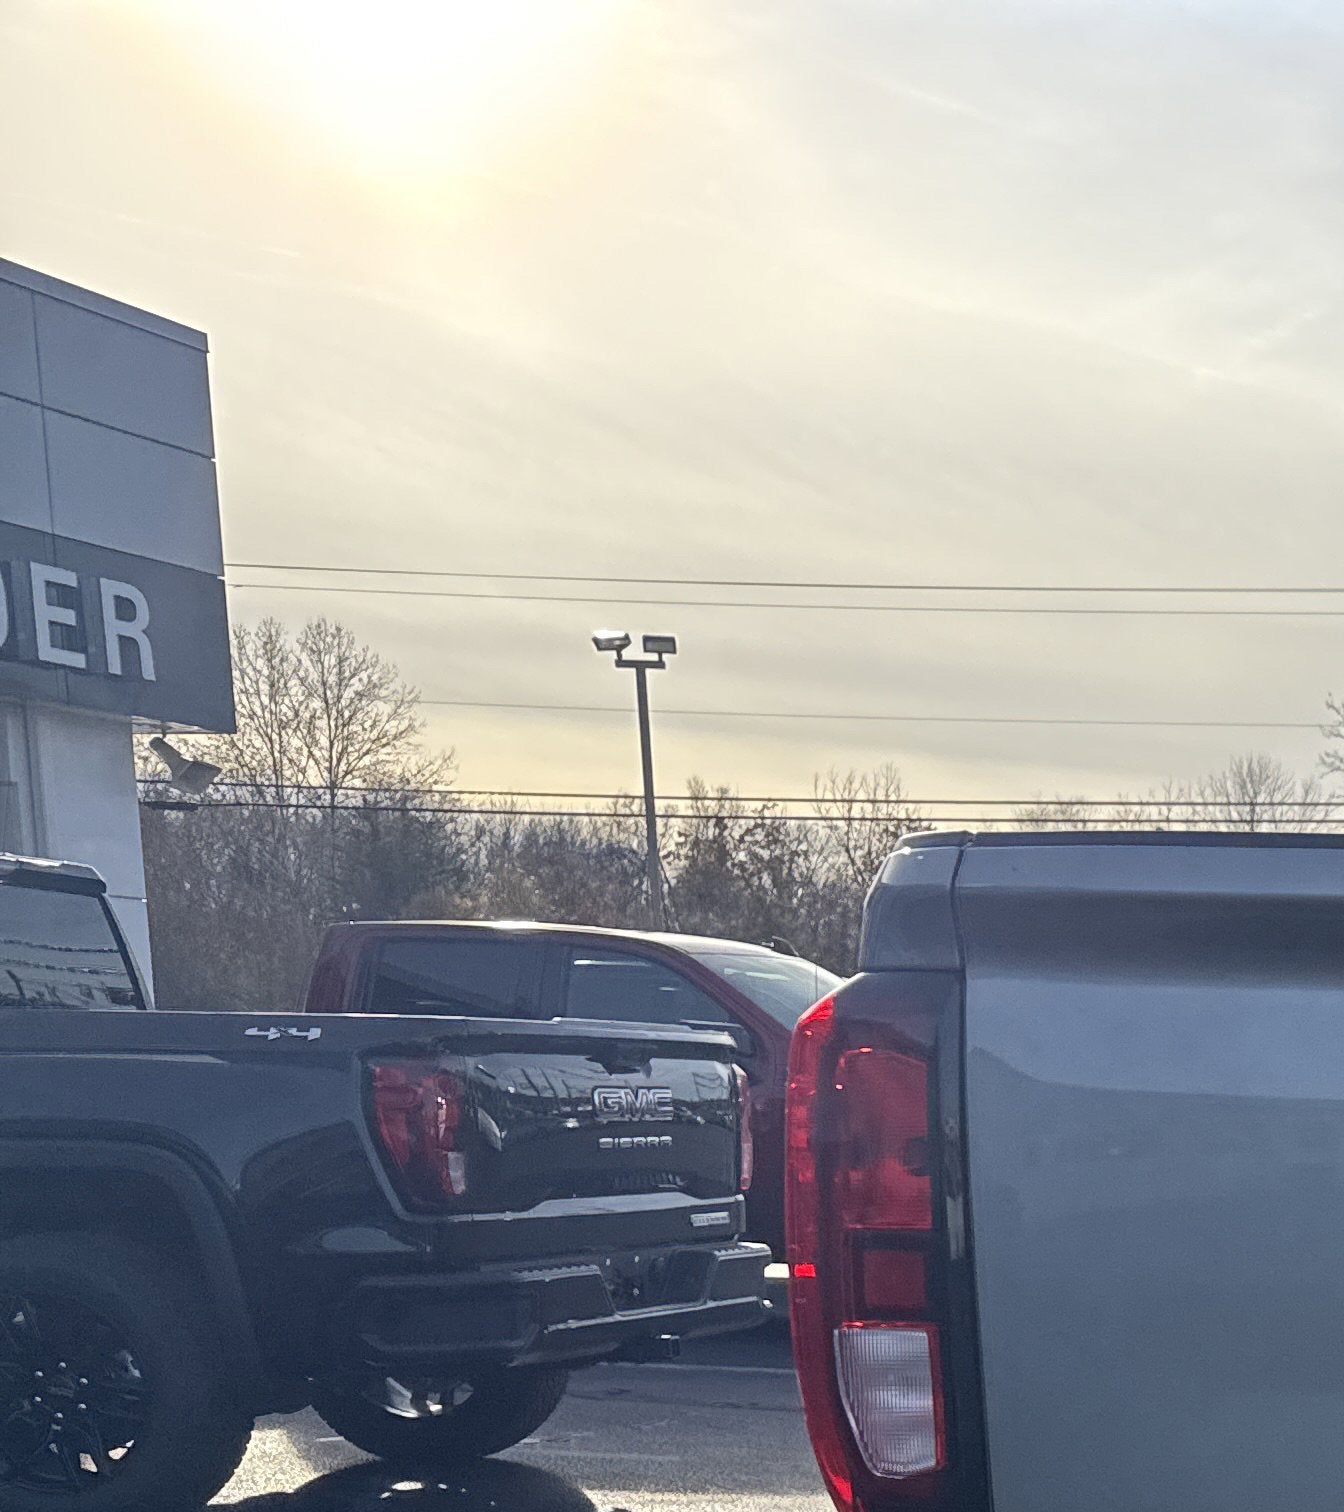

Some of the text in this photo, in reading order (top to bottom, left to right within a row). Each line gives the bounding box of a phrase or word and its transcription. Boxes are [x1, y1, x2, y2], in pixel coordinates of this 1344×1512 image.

[0, 561, 156, 681] ER
[593, 1086, 674, 1122] GMC
[599, 1135, 673, 1149] SIERRA
